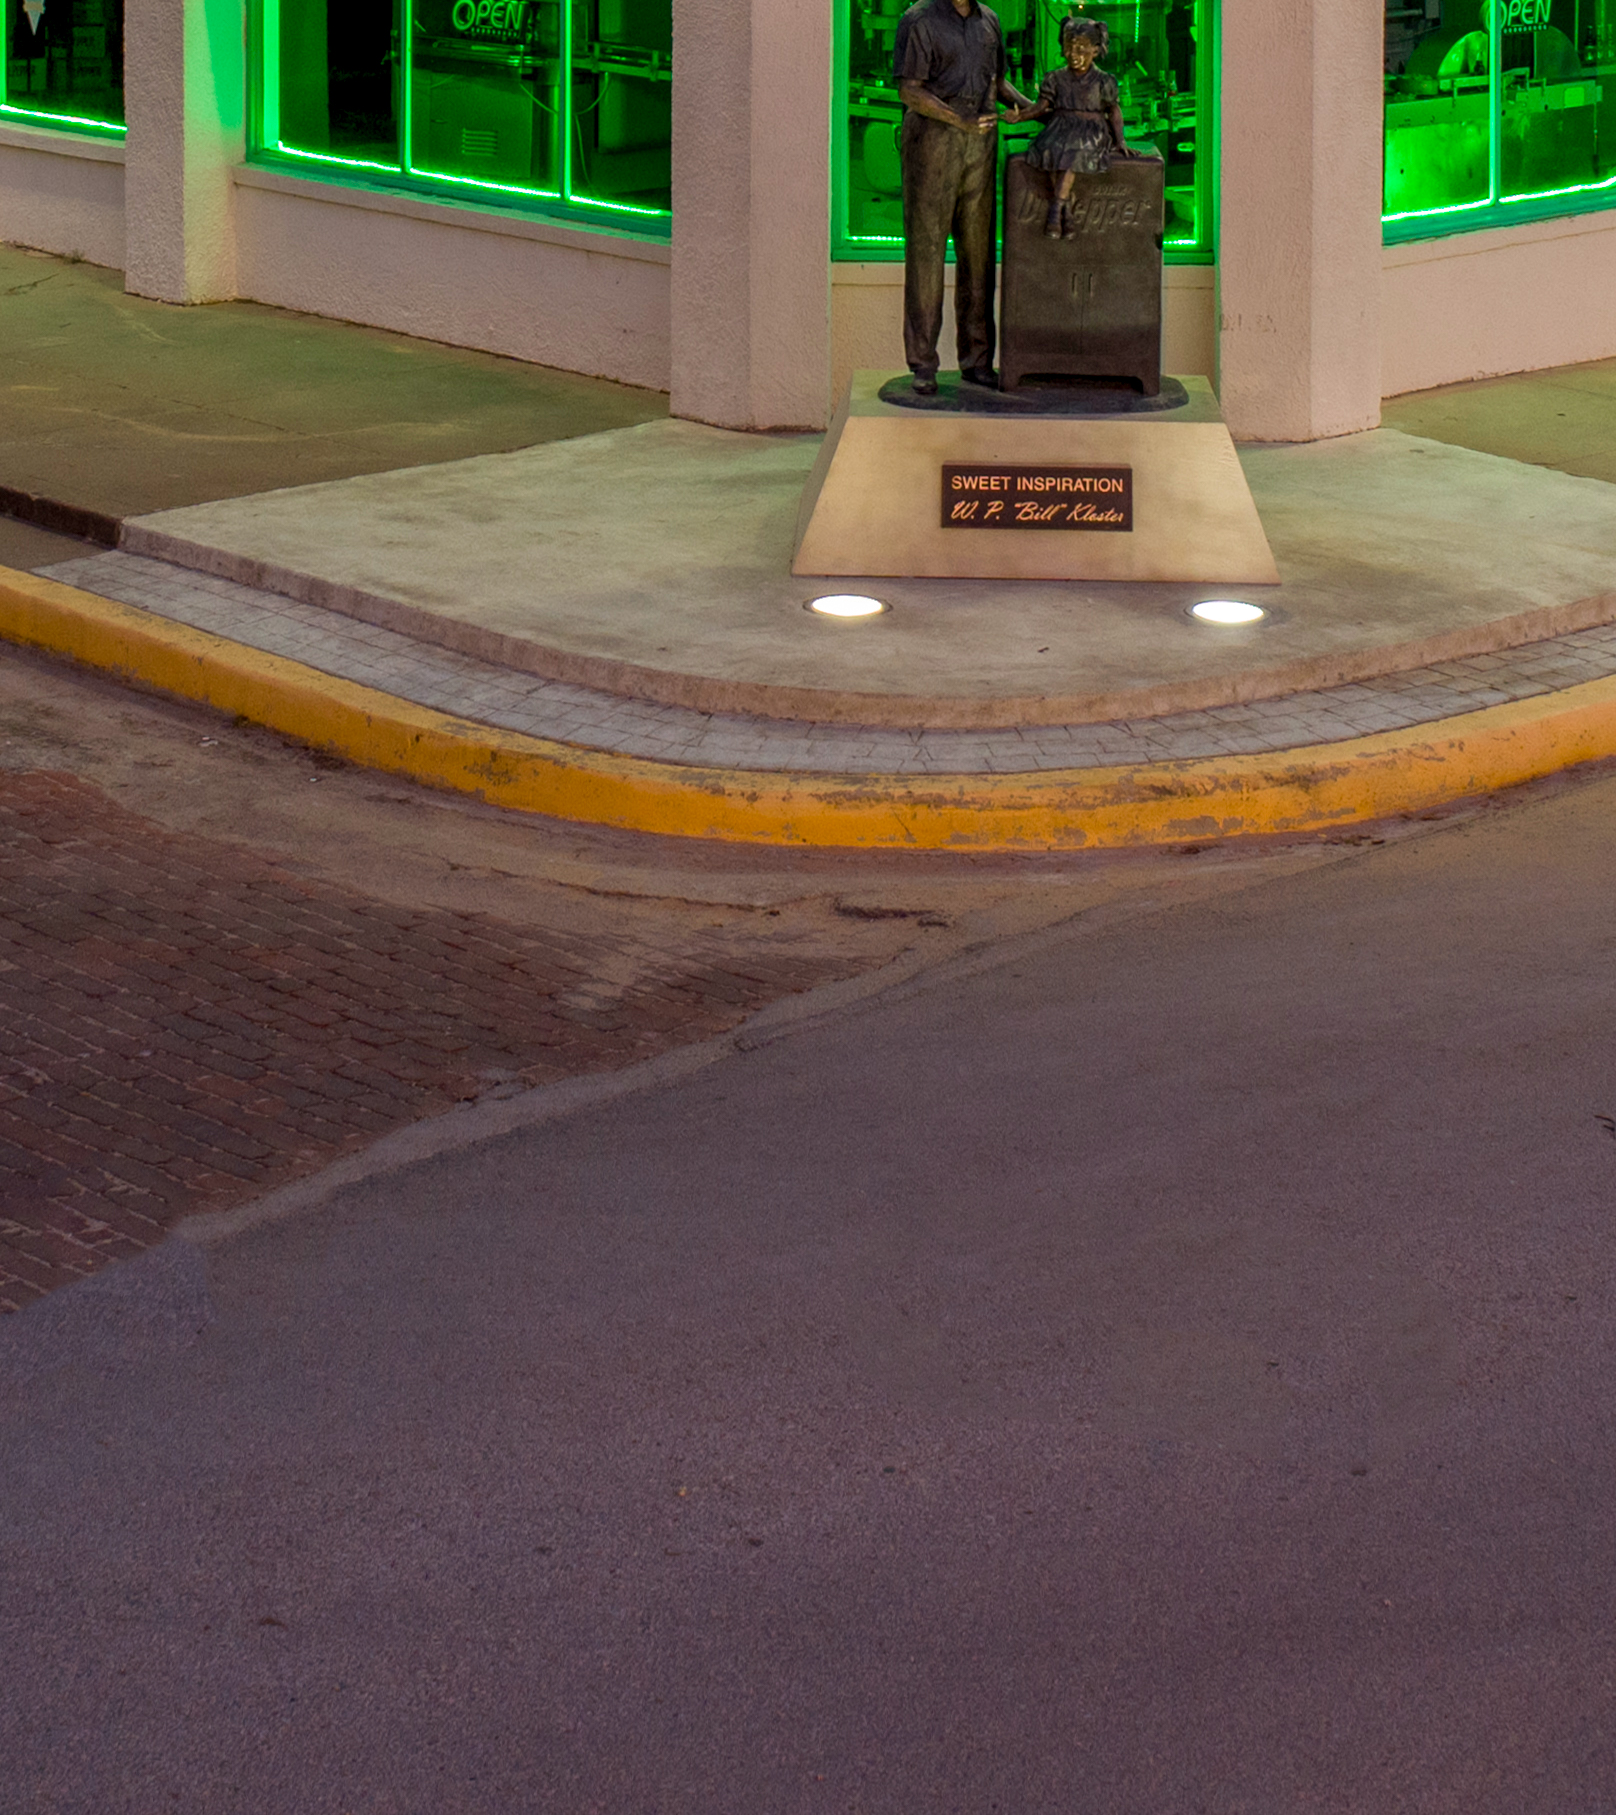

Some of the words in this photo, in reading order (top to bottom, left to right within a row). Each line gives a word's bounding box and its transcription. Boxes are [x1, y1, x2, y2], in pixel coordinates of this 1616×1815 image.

[1070, 190, 1152, 233] epper
[951, 475, 1012, 491] SWEET
[1016, 476, 1124, 493] INSPIRATION
[950, 500, 979, 520] W.
[983, 500, 1004, 520] P.
[1066, 502, 1124, 523] Kloster
